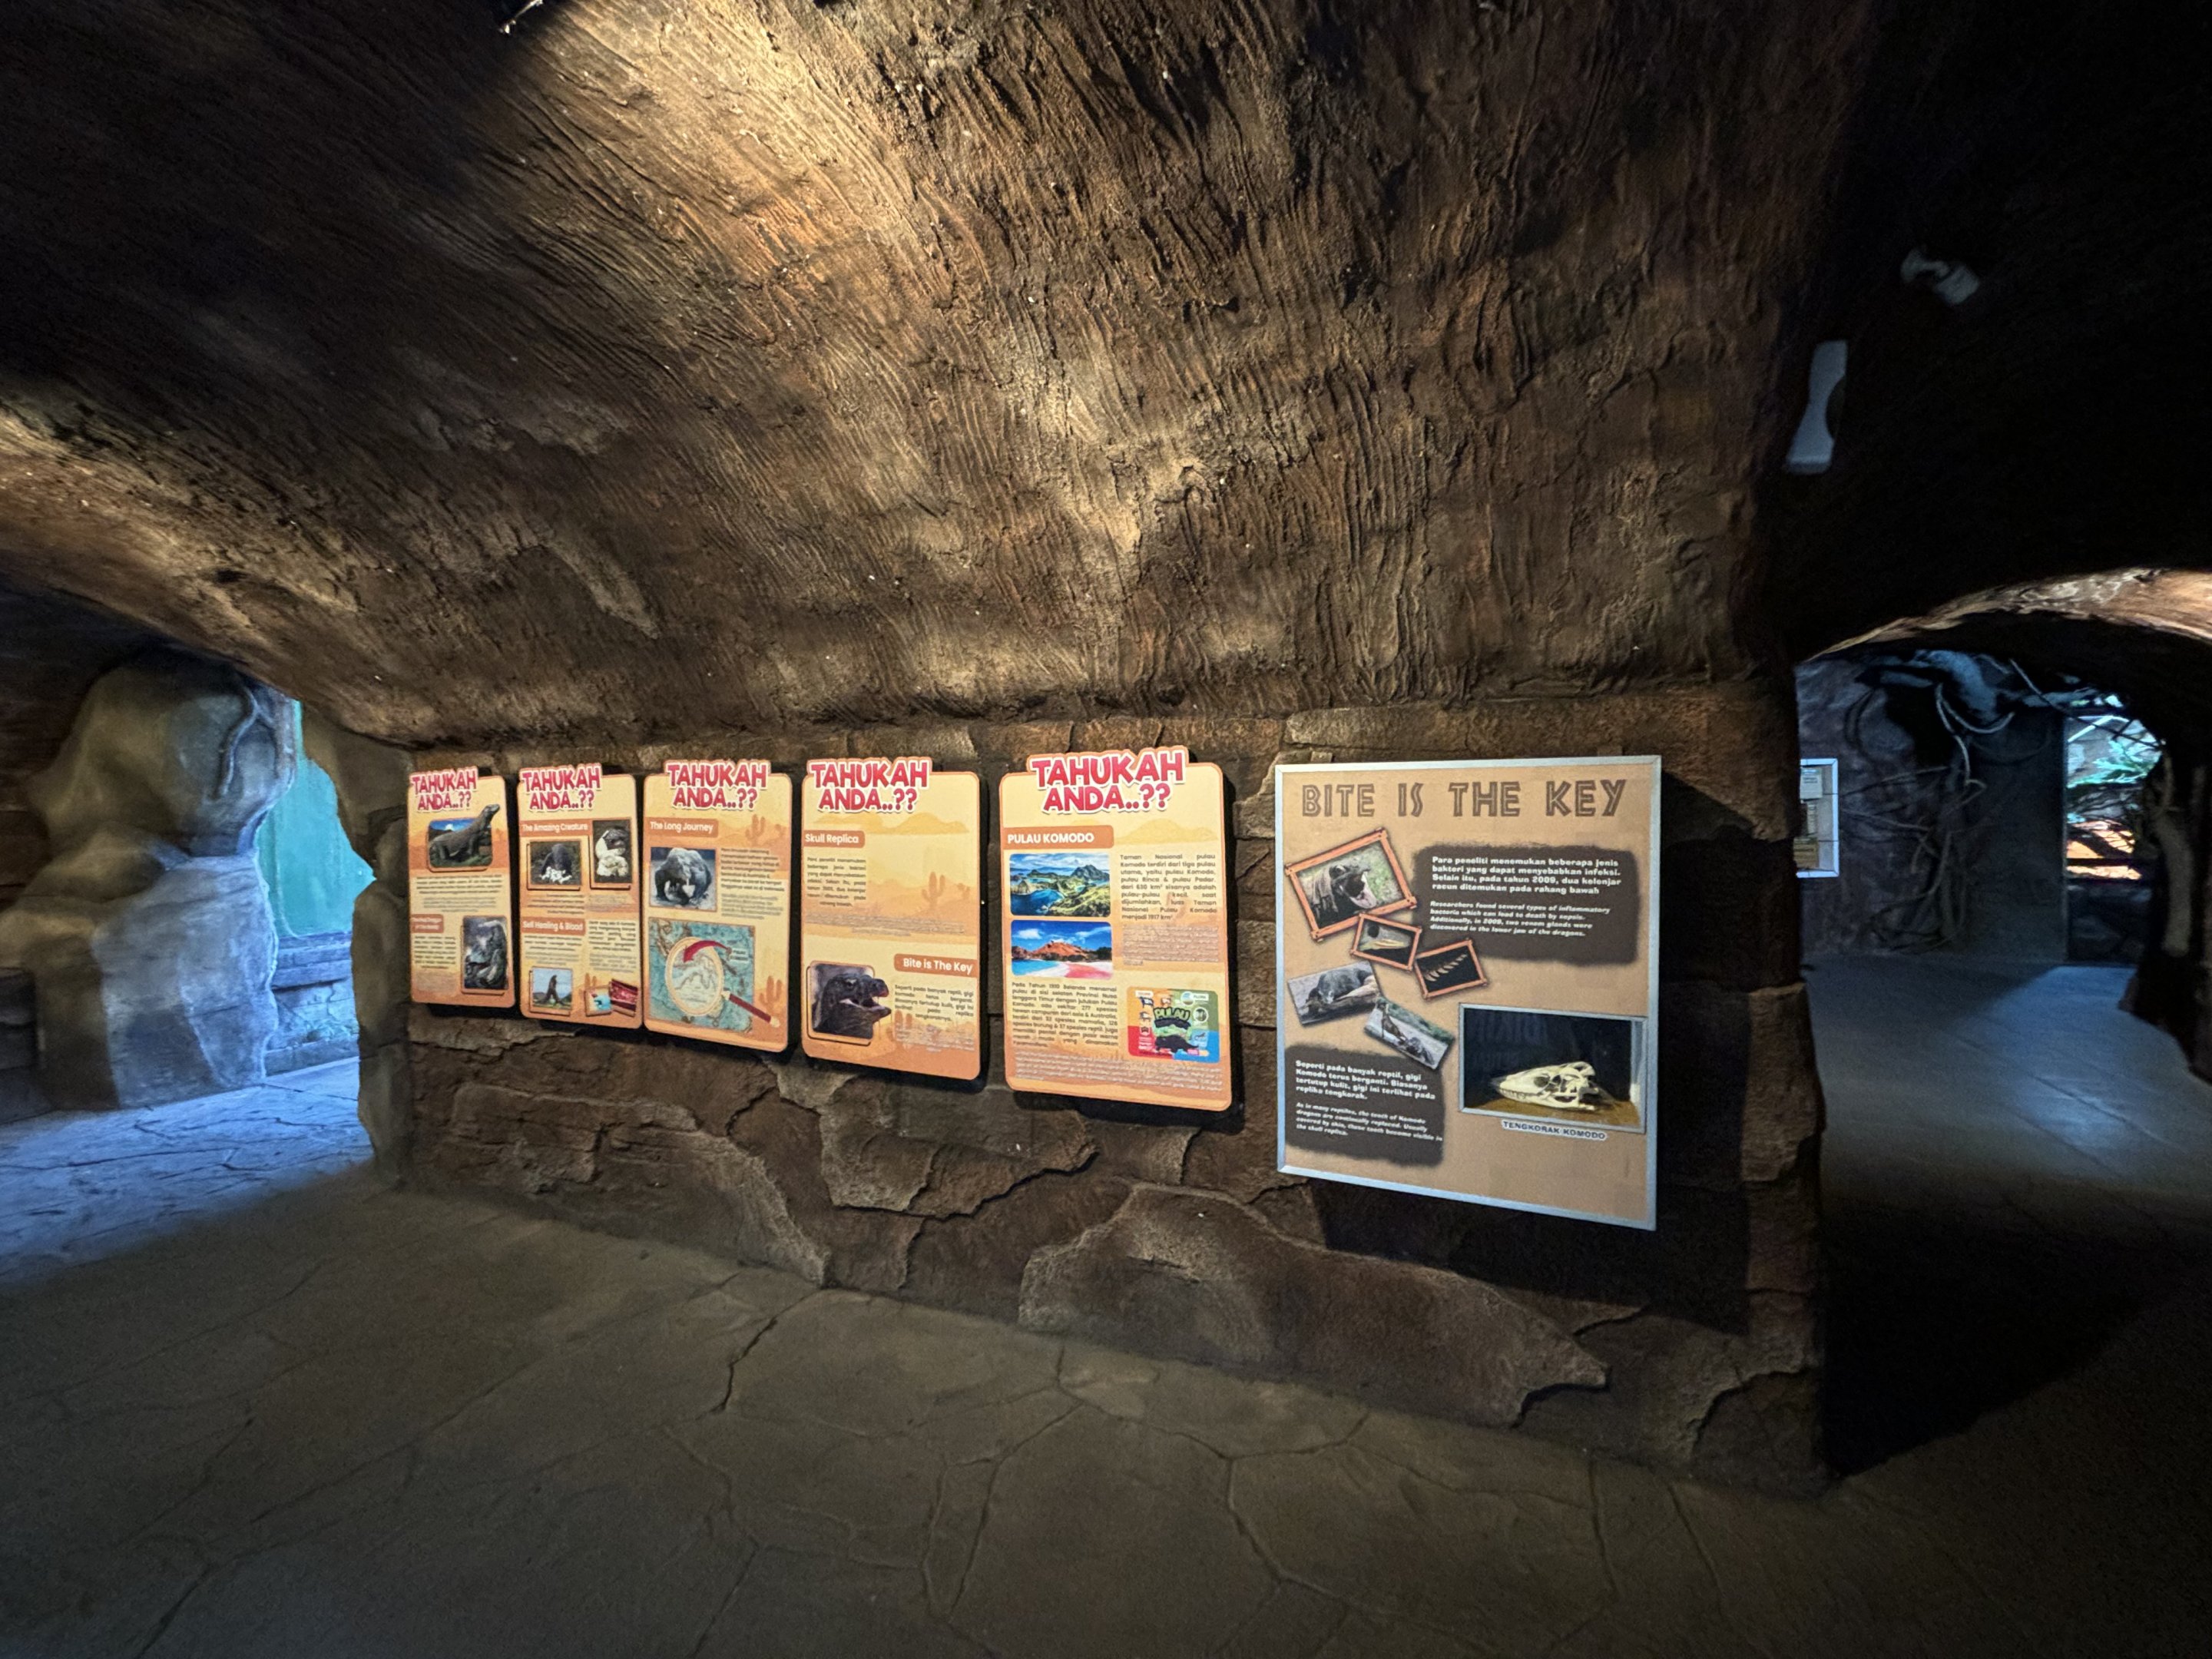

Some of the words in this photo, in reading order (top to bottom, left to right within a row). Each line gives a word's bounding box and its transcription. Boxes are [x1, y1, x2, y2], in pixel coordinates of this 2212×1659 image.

[667, 764, 767, 787] TAHUKAH
[811, 763, 927, 787] TAHUKAH
[1032, 752, 1184, 787] TAHUKAH
[412, 770, 476, 794] TAHUKAH
[522, 767, 601, 792] TAHUKAH
[418, 791, 471, 810] ANDA..??
[530, 790, 594, 810] ANDA..??
[673, 788, 757, 809] ANDA..??
[819, 788, 917, 811] ANDA..??
[1044, 783, 1171, 811] ANDA..??
[1302, 783, 1375, 817] BITE
[1398, 783, 1423, 817] IS
[1449, 781, 1521, 817] THE
[1545, 779, 1627, 817] KEY
[664, 822, 681, 833] Long
[683, 823, 714, 834] Journey
[805, 834, 824, 843] Skull
[826, 834, 859, 845] Replica
[1008, 834, 1041, 843] PULAU
[1043, 833, 1094, 843] KOMODO
[1455, 856, 1488, 865] peneliti
[1548, 858, 1593, 866] beberapa
[1595, 859, 1618, 867] jenis
[1462, 874, 1477, 882] itu,
[1479, 875, 1501, 883] pada
[1532, 876, 1559, 885] 2009,
[1582, 877, 1621, 886] kelenjar
[1518, 867, 1582, 876] menyebabkan
[1584, 868, 1621, 876] infeksi.
[1460, 883, 1507, 892] ditemukan
[1509, 885, 1532, 893] pada
[1535, 886, 1567, 895] rahang
[1558, 906, 1611, 915] inflammatory
[903, 958, 922, 969] Bite
[923, 959, 931, 969] is
[934, 960, 952, 971] The
[954, 962, 972, 975] Key
[1154, 1007, 1190, 1021] PULAU
[1296, 1060, 1324, 1070] Seperti
[1347, 1065, 1376, 1075] banyak
[1378, 1071, 1403, 1079] reptil,
[1406, 1074, 1422, 1082] gigi
[1296, 1068, 1327, 1078] Komodo
[1352, 1075, 1389, 1085] berganti.
[1391, 1079, 1428, 1091] Biasanya
[1296, 1077, 1328, 1088] tertutup
[1330, 1080, 1350, 1090] kulit,
[1353, 1084, 1368, 1092] gigi
[1382, 1088, 1412, 1097] terlihat
[1325, 1089, 1367, 1099] tengkorak.
[1503, 1121, 1560, 1134] TENGKORAK
[1563, 1128, 1605, 1139] KOMODO
